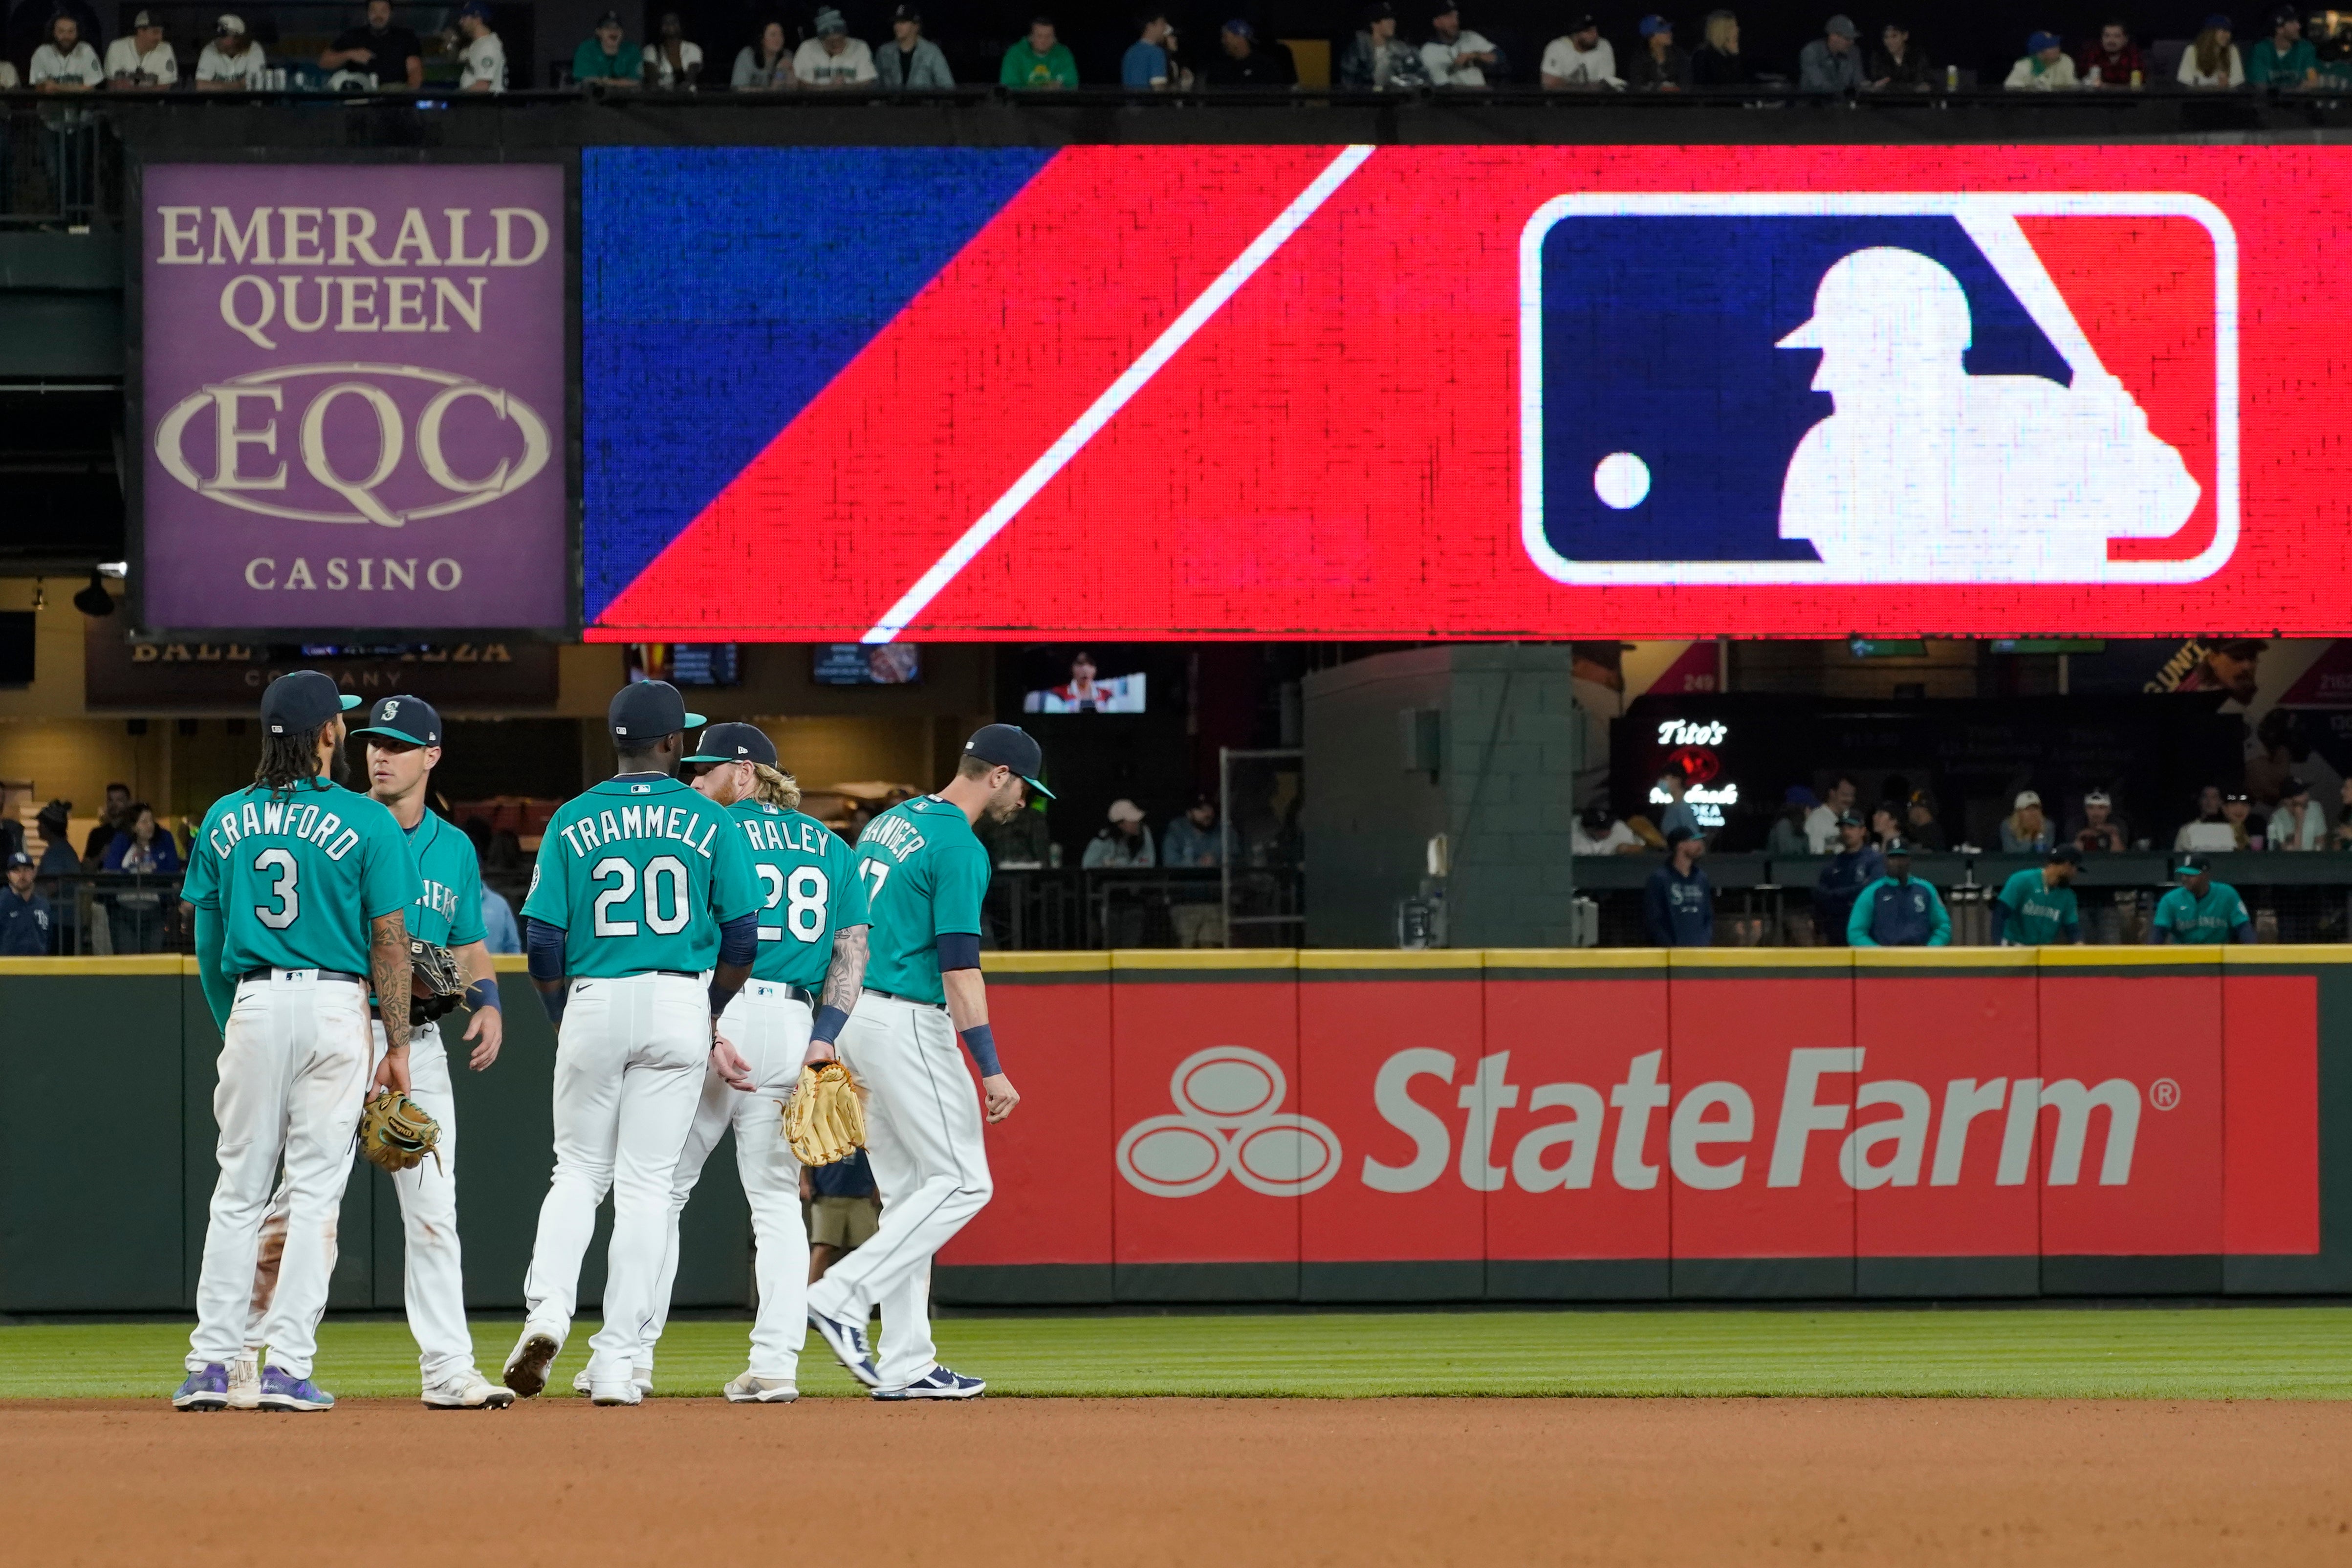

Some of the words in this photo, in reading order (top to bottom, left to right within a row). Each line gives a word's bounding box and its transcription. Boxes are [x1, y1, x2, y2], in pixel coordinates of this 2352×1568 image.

[156, 206, 550, 266] EMERALD
[219, 275, 488, 349] QUEEN
[198, 383, 507, 527] EQC
[245, 558, 462, 590] CASINO
[1657, 718, 1728, 746] Tito's
[210, 802, 359, 861] CRAWFORD
[560, 804, 719, 859] TRAMMELL
[254, 847, 300, 930] 3
[591, 854, 691, 938] 20
[755, 863, 830, 944] 28
